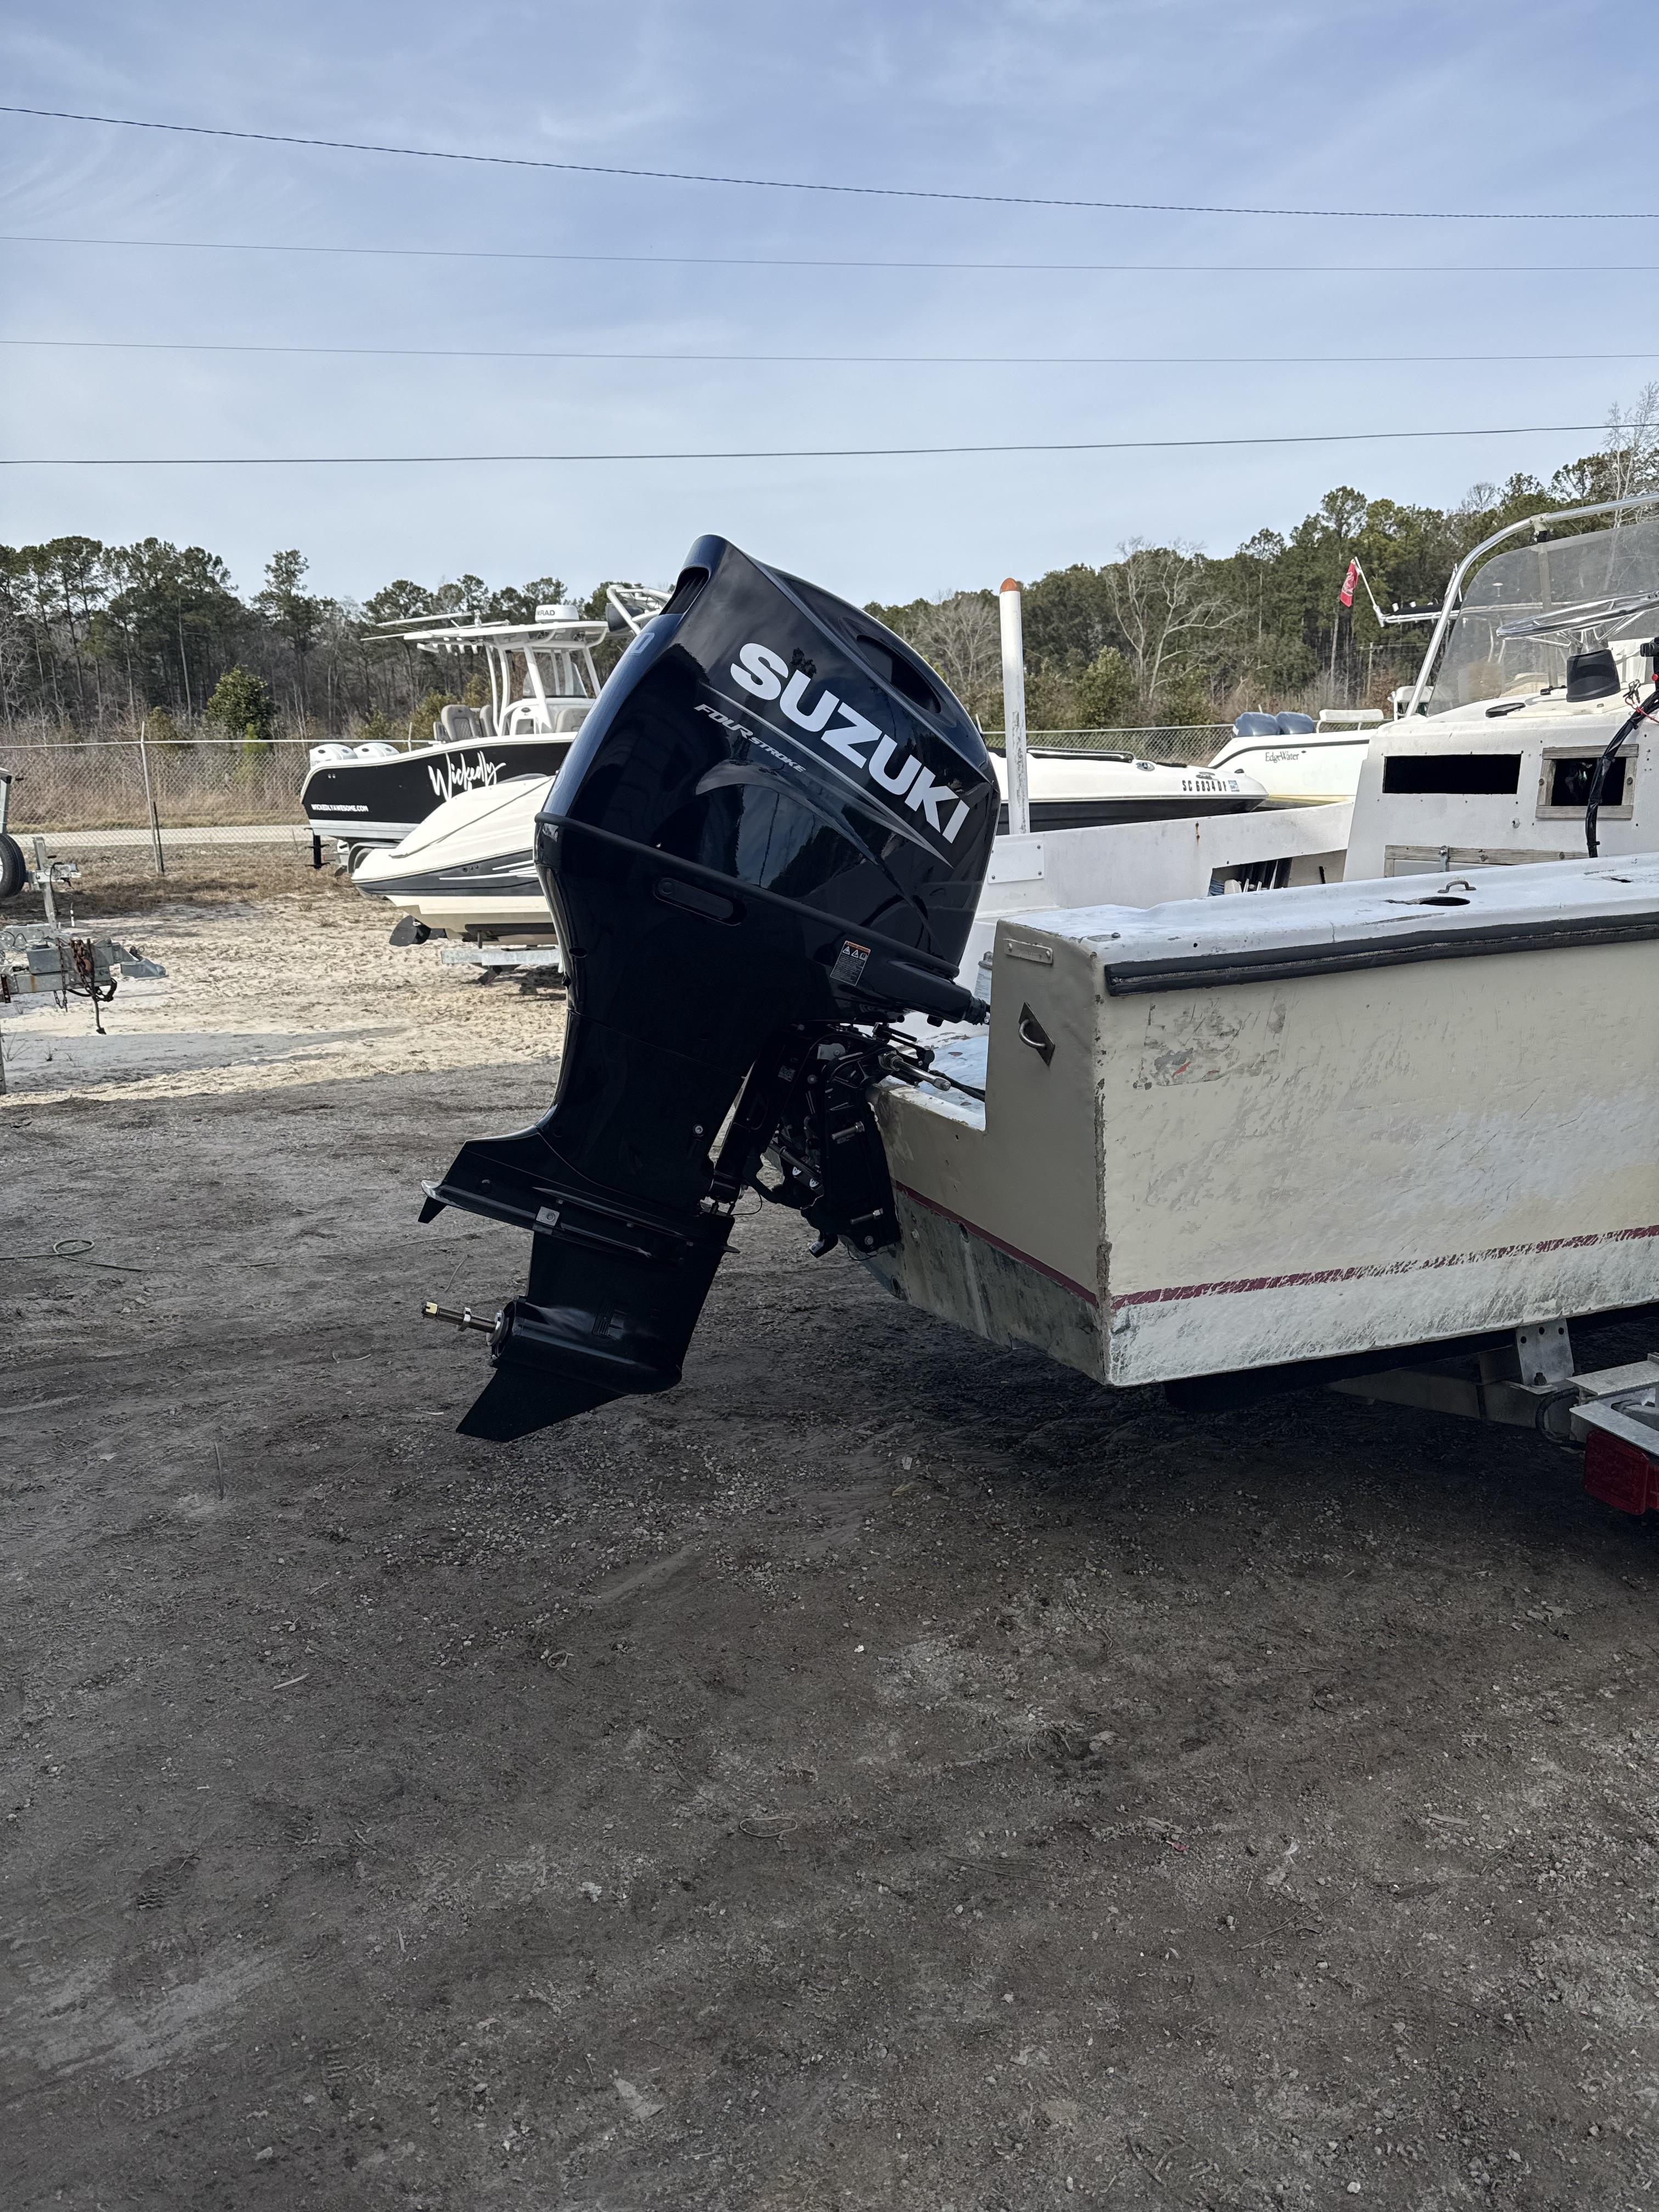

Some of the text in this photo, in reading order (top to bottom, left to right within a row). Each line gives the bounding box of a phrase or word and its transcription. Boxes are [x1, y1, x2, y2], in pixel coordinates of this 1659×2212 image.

[730, 642, 970, 844] SUZUKI
[1265, 751, 1299, 763] EdgeWater
[428, 751, 506, 802] Wickedly
[1182, 780, 1193, 791] SC
[1195, 780, 1216, 792] 6834
